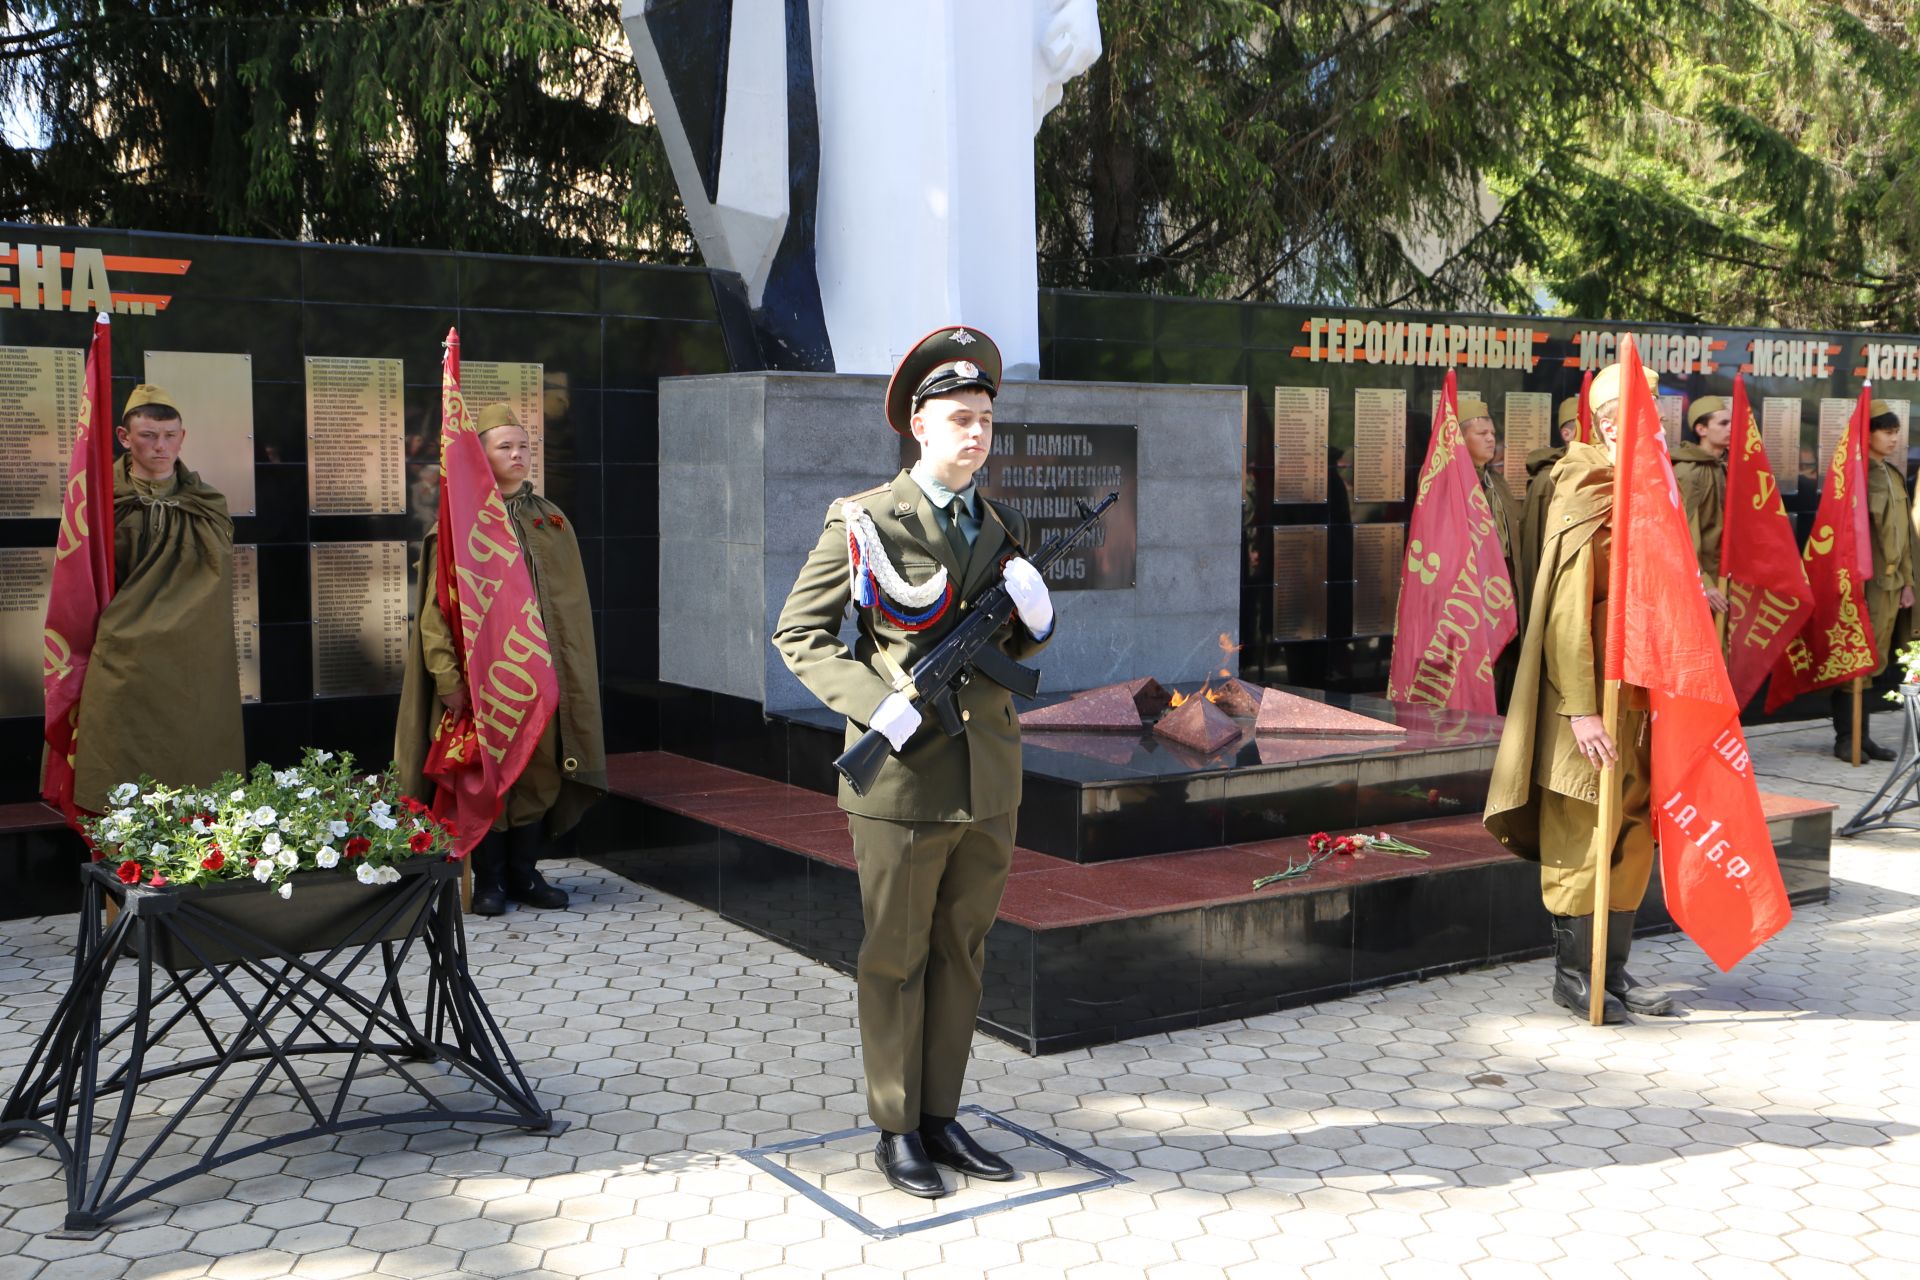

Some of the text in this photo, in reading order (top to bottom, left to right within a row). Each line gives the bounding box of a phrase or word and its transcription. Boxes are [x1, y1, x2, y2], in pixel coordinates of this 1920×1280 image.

[1309, 317, 1534, 373] ГЕРОИЛАРНЫҢ
[1753, 338, 1829, 380] МӘҢГЕ
[1866, 343, 1920, 381] ХӘТЕ
[989, 434, 1093, 457] АЯ ПАМЯТЬ
[1001, 465, 1121, 490] ПОБЕДИТЕЛЯМ
